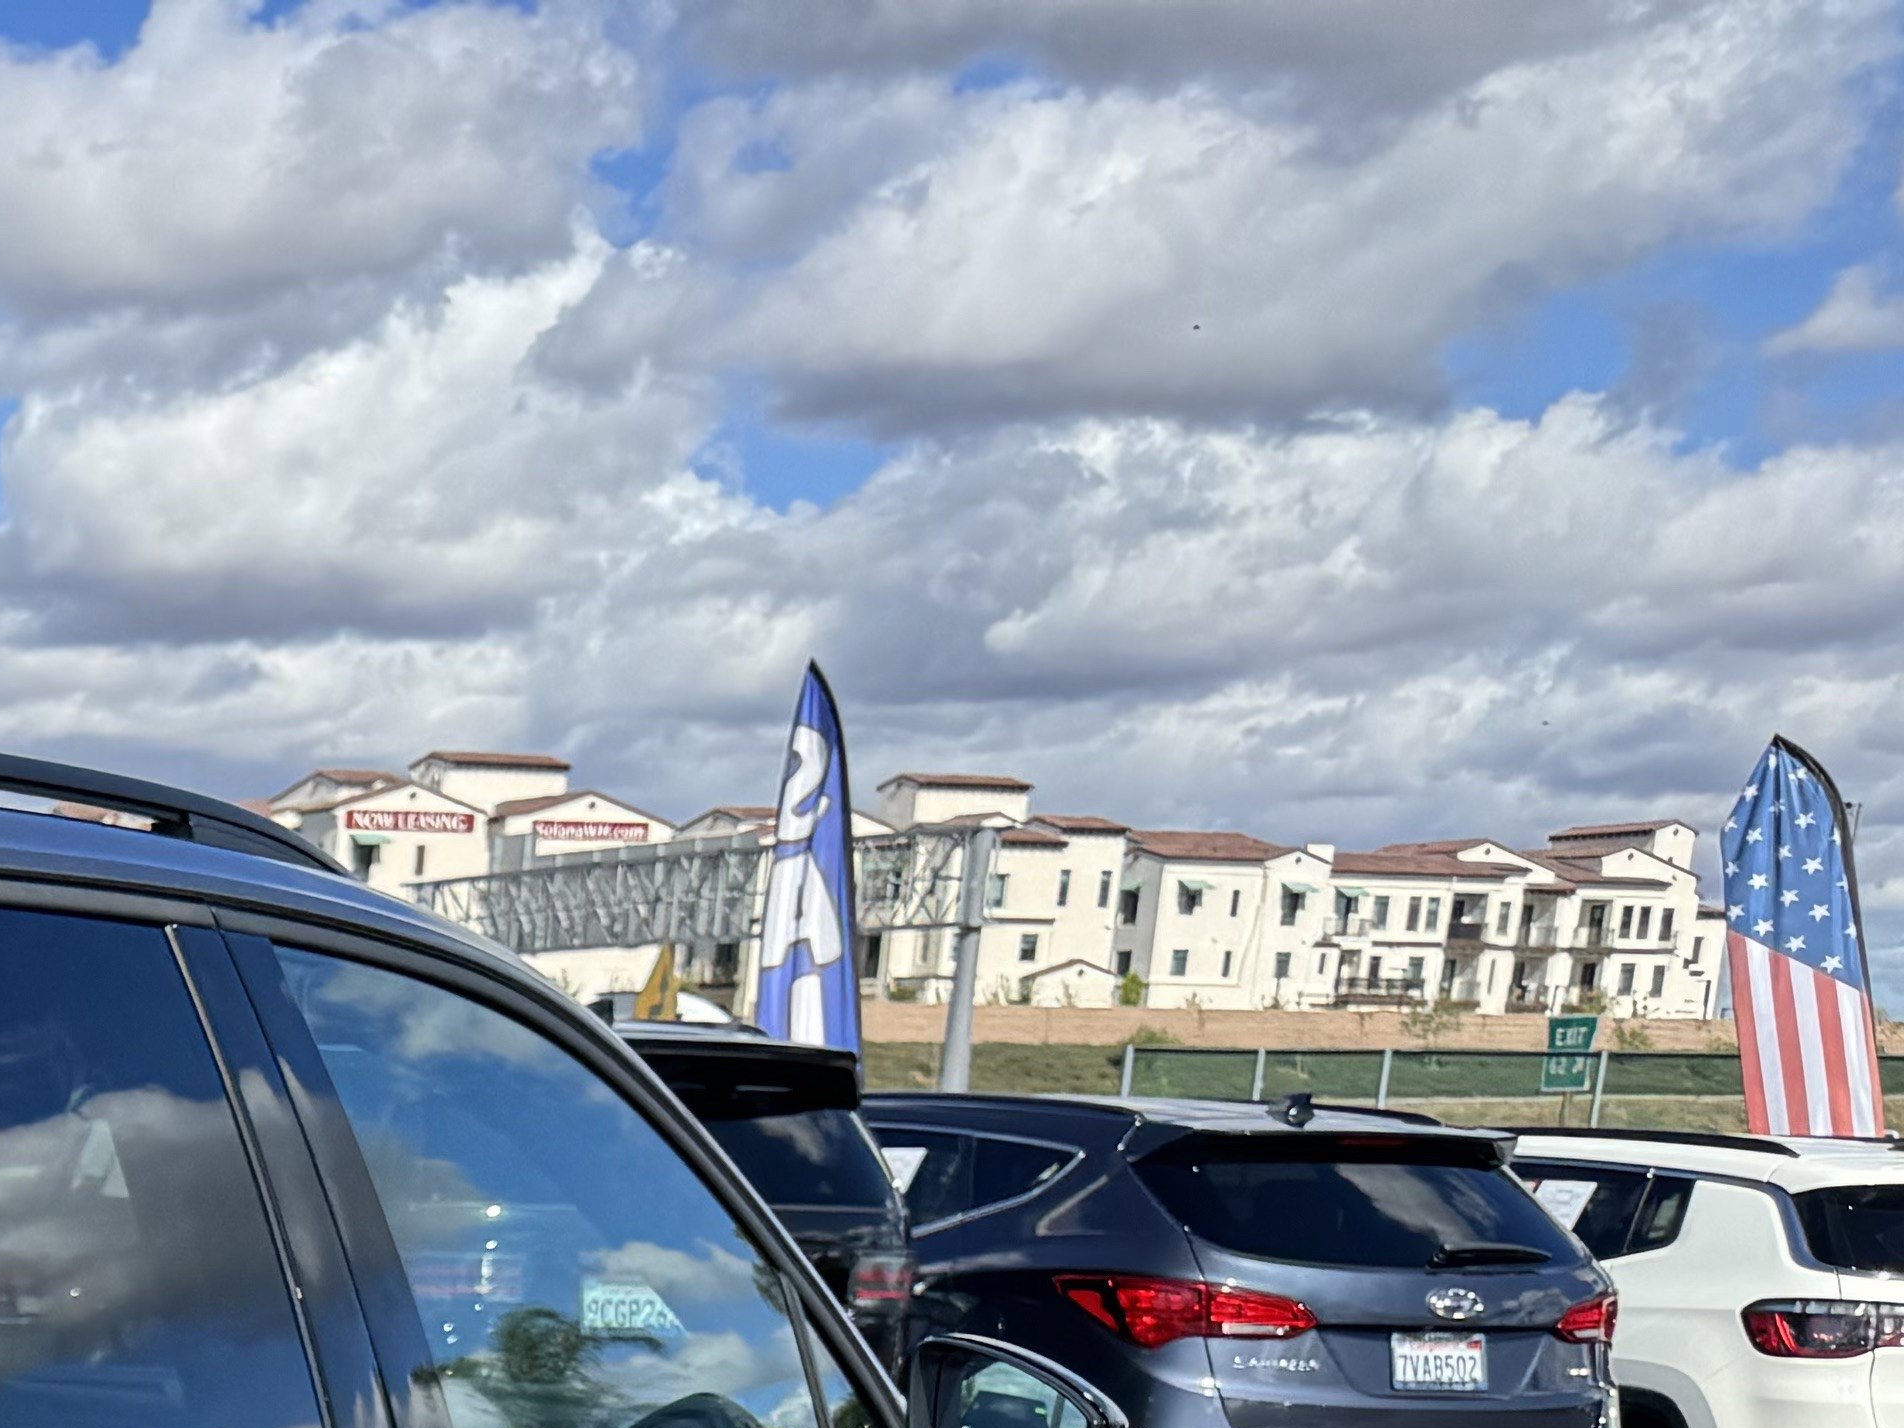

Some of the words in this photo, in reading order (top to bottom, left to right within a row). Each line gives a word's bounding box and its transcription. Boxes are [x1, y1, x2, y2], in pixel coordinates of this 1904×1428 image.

[352, 811, 393, 829] NOW
[397, 812, 469, 832] LEASING
[1555, 1027, 1588, 1047] EXIT
[588, 1298, 676, 1328] 9CGP26
[1398, 1355, 1479, 1383] 7VAB502
